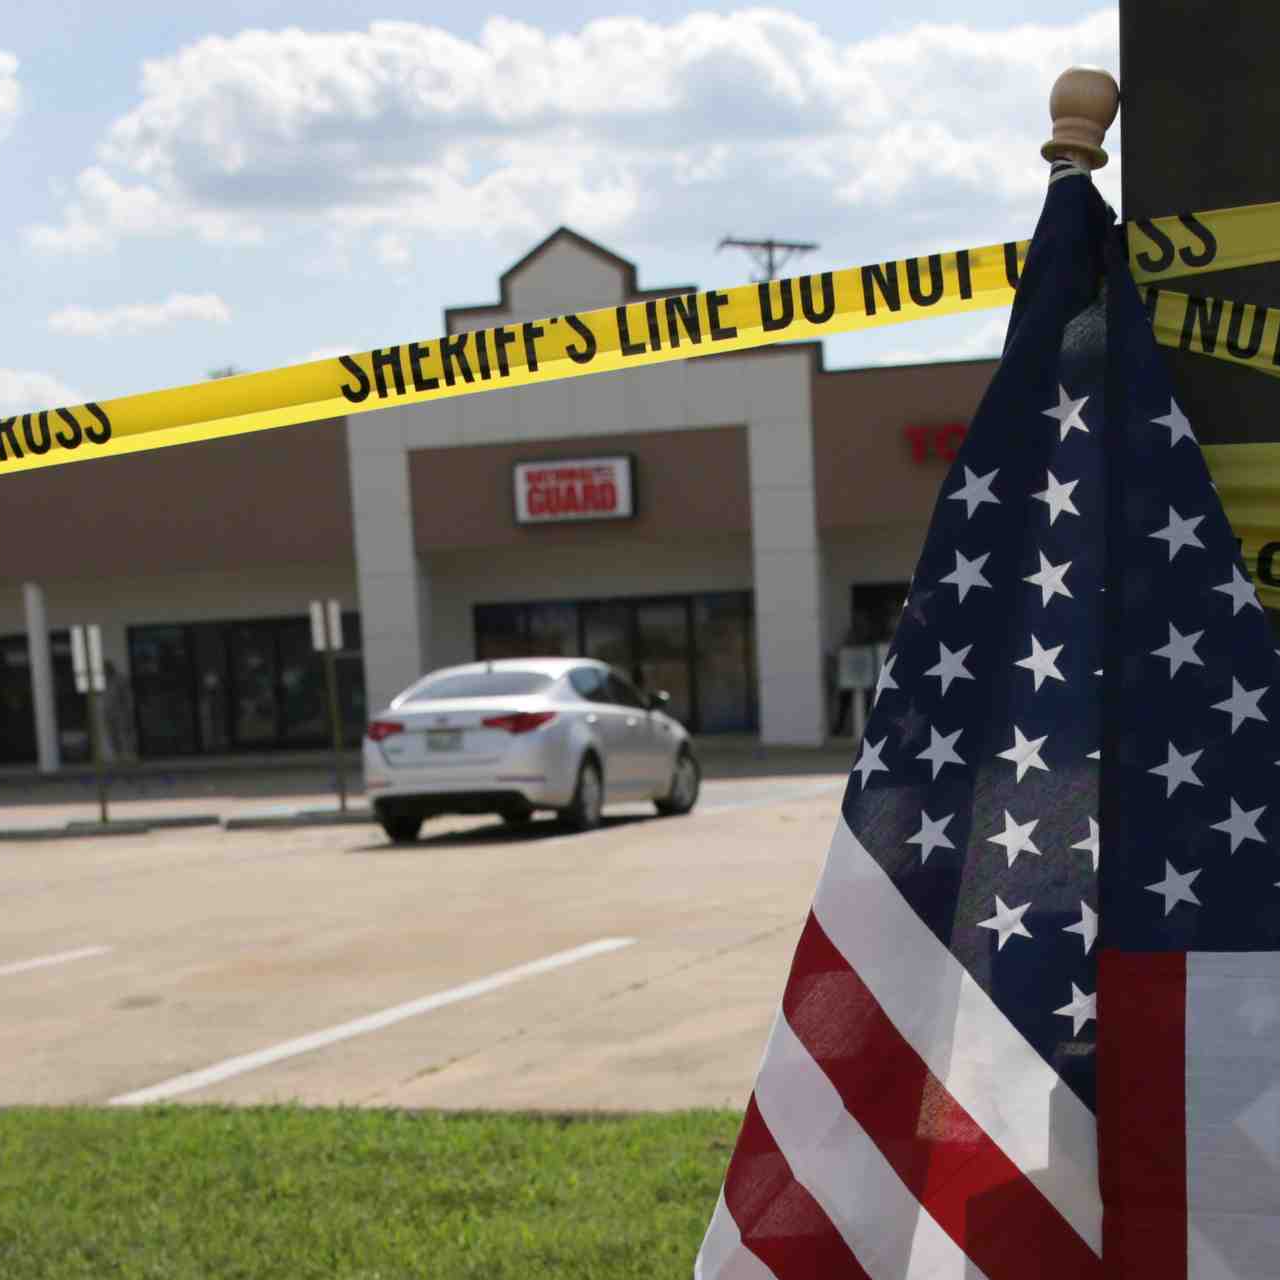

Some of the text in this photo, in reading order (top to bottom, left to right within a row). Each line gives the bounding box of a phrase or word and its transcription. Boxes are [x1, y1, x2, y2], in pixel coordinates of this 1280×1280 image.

[338, 313, 598, 403] SHERIFF'S
[615, 290, 737, 357] LINE
[757, 271, 836, 332] DO
[860, 248, 973, 317] NOT
[527, 481, 617, 517] GUARD
